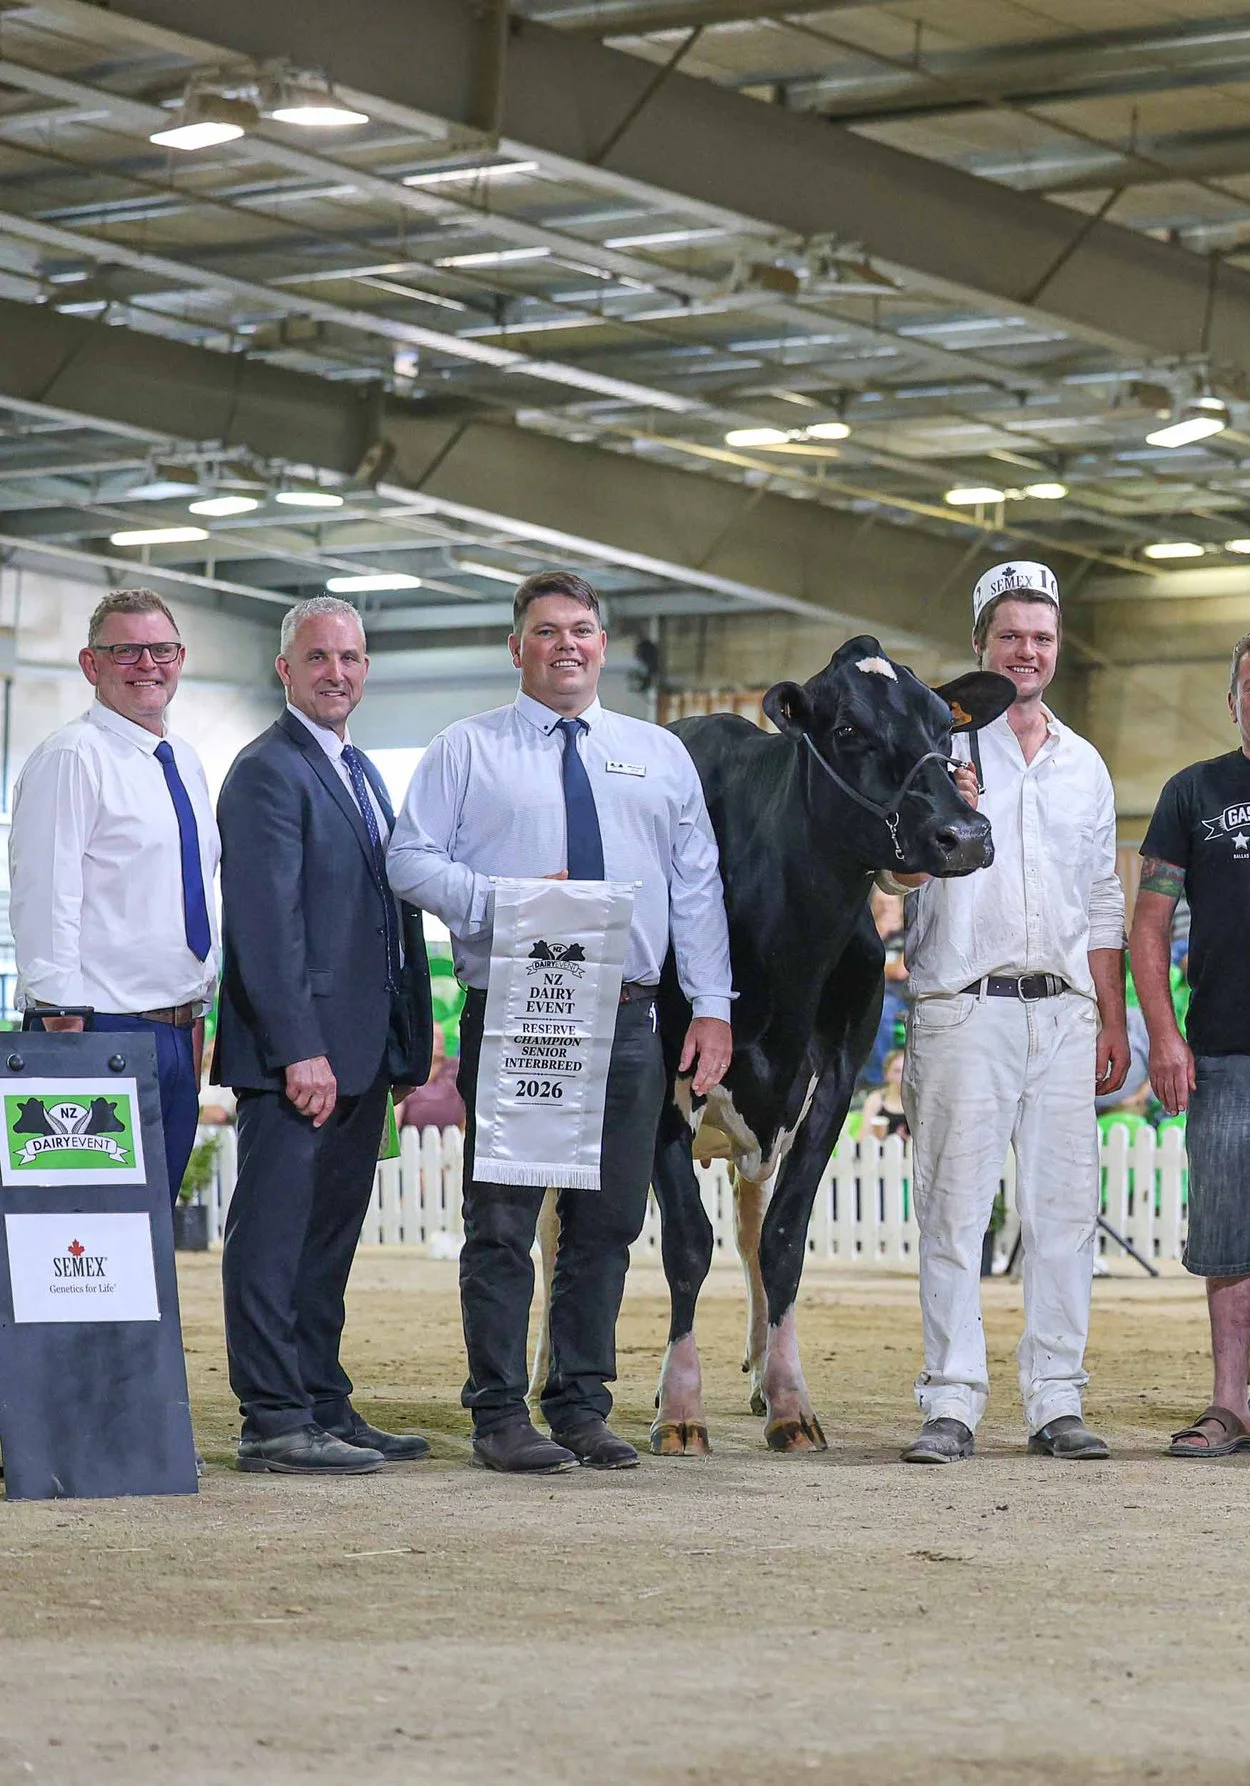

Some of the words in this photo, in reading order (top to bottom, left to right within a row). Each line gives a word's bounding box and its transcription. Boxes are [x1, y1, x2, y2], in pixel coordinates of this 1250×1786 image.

[990, 575, 1034, 596] SEMEX
[543, 973, 564, 986] NZ
[529, 987, 576, 1000] DAIRY
[526, 1001, 576, 1014] EVENT
[522, 1023, 576, 1036] RESERVE
[513, 1035, 582, 1047] CHAMPION
[521, 1046, 567, 1058] SENIOR
[505, 1057, 582, 1072] INTERBREED
[515, 1080, 563, 1098] 2026
[60, 1107, 79, 1119] NZ
[32, 1136, 112, 1152] DAIRYEVENT
[53, 1256, 106, 1278] SEMEX
[49, 1283, 84, 1294] Genetics
[85, 1283, 97, 1293] for
[98, 1282, 115, 1293] Life
